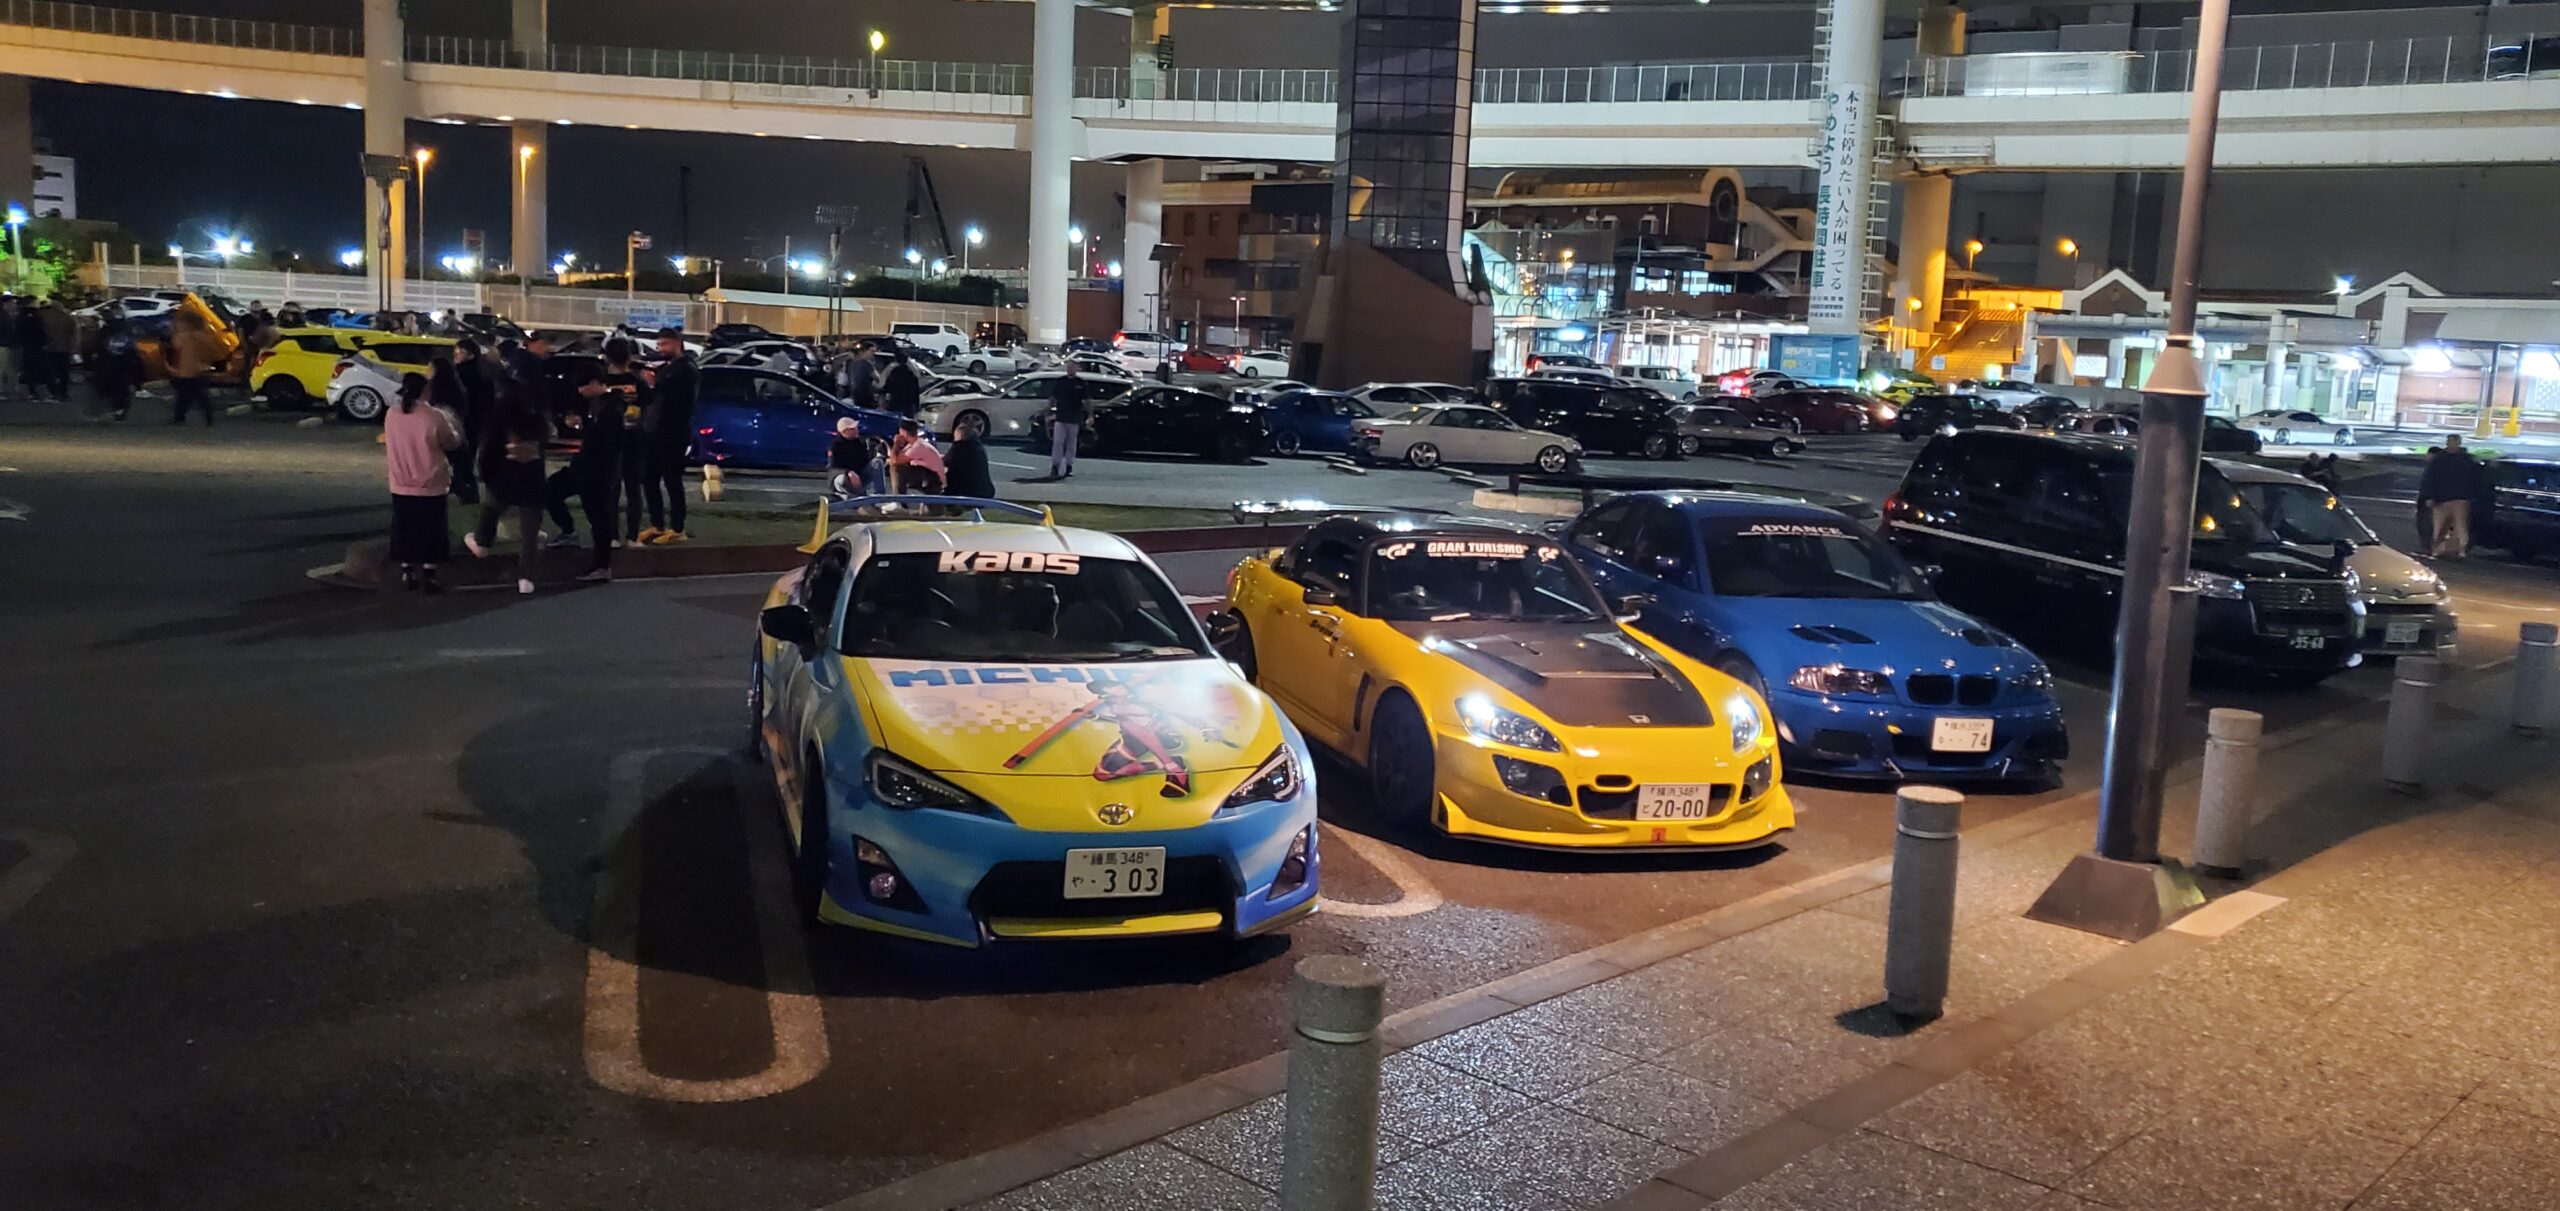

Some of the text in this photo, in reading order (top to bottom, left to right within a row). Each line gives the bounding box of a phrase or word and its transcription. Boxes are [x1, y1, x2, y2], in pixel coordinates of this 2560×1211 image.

[1822, 91, 1840, 175] やめよう
[1831, 90, 1859, 290] 本当に停めたい人が困ってる
[1812, 184, 1831, 289] 長時間駐車
[1750, 524, 1842, 535] ADVANCE
[1427, 542, 1525, 554] GRAN TURISMO
[1653, 799, 1704, 818] 20-00
[1120, 851, 1144, 865] 348
